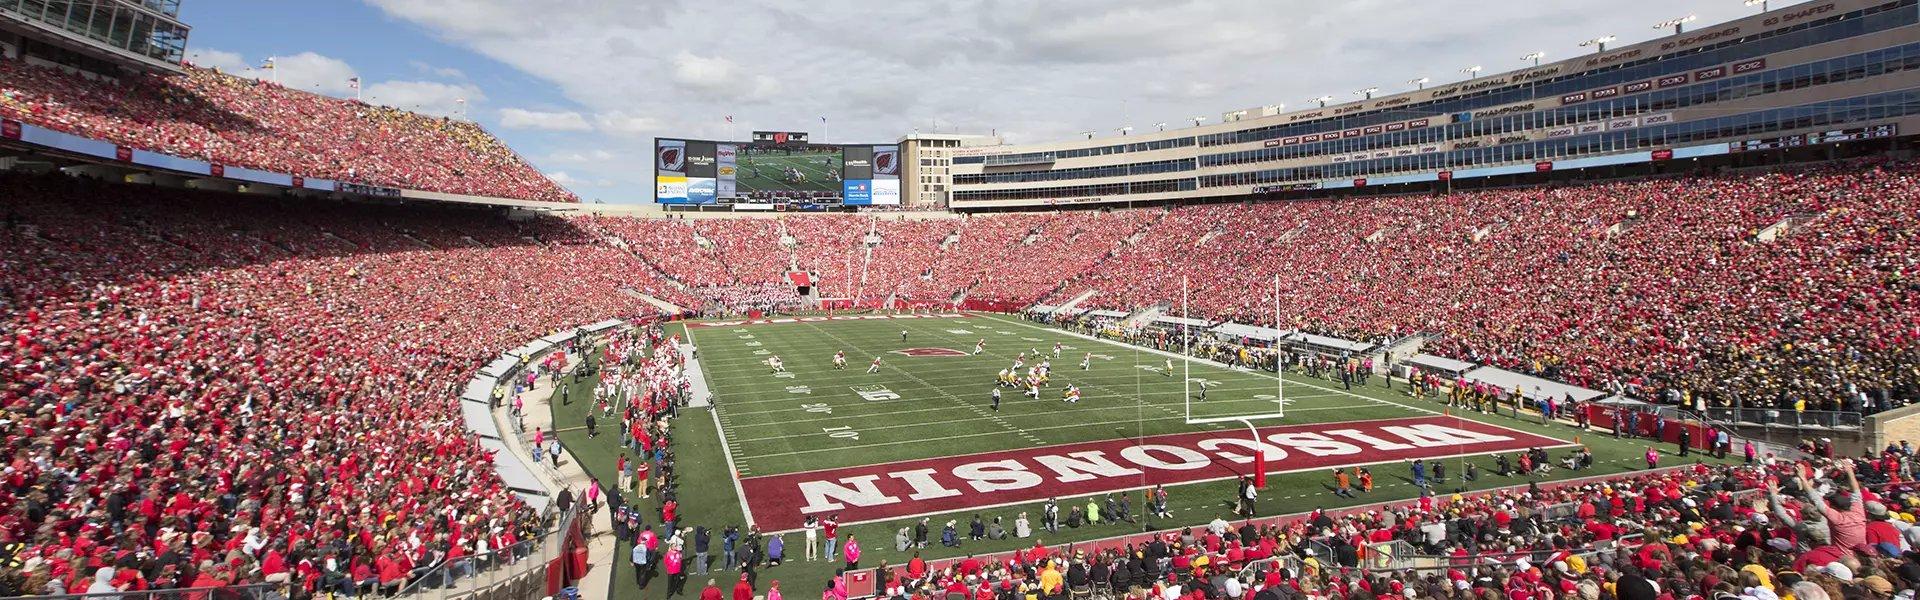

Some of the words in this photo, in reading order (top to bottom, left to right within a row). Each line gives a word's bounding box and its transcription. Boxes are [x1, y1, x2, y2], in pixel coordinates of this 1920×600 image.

[1782, 4, 1835, 22] SHAFER
[1600, 49, 1641, 63] RICHTER
[1737, 61, 1761, 71] 2012
[1700, 69, 1720, 79] 2011
[1432, 87, 1458, 98] CAMP
[1461, 78, 1507, 91] RANDALL
[1512, 67, 1559, 82] STADIUM
[1661, 76, 1685, 86] 2010
[1385, 97, 1411, 106] HIRSCH
[1343, 105, 1364, 114] DAYNE
[1474, 103, 1535, 118] CHAMPIONS
[774, 133, 788, 144] W
[1549, 129, 1571, 137] 2000
[1455, 140, 1479, 149] ROSE
[1500, 135, 1530, 144] BOWL
[798, 424, 1515, 514] WISCONSIN
